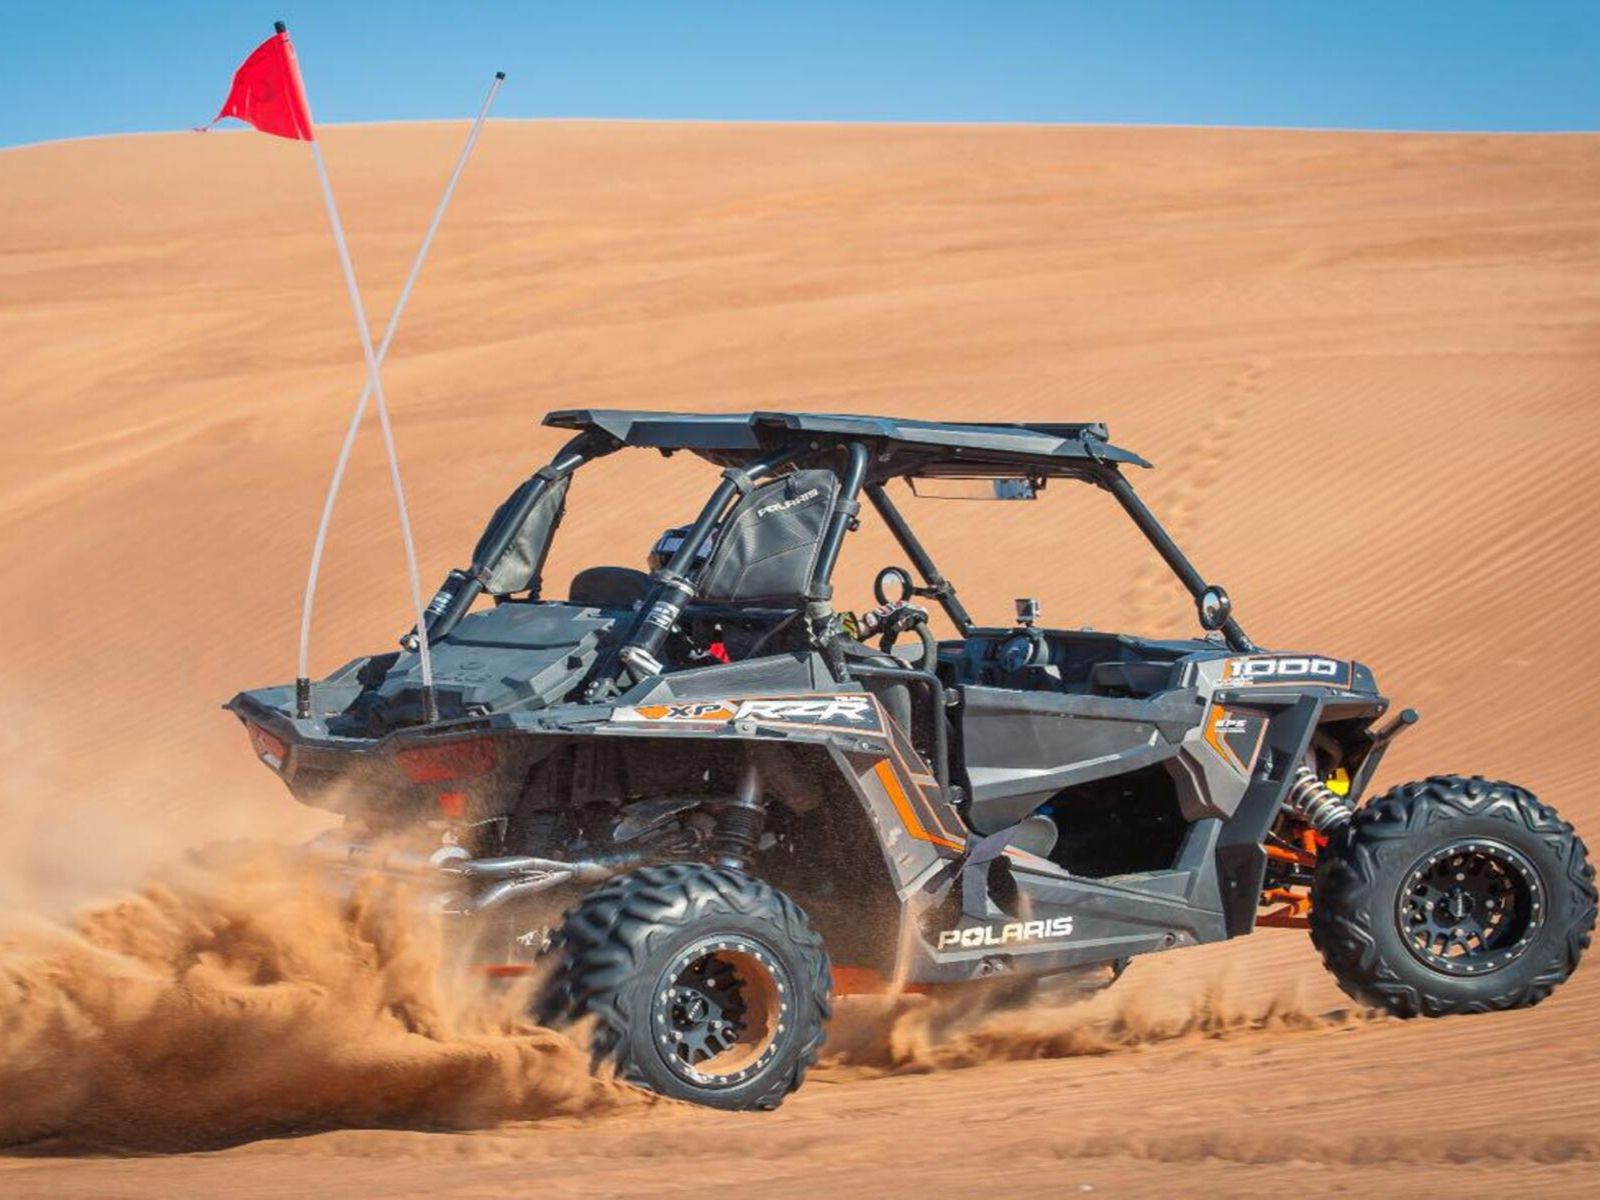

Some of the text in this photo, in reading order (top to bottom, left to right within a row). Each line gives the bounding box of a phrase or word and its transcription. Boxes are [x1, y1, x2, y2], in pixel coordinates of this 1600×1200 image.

[757, 488, 819, 517] POLARIS
[1231, 658, 1338, 676] 1000
[668, 700, 868, 722] XP RZR
[937, 915, 1074, 950] POLARIS
